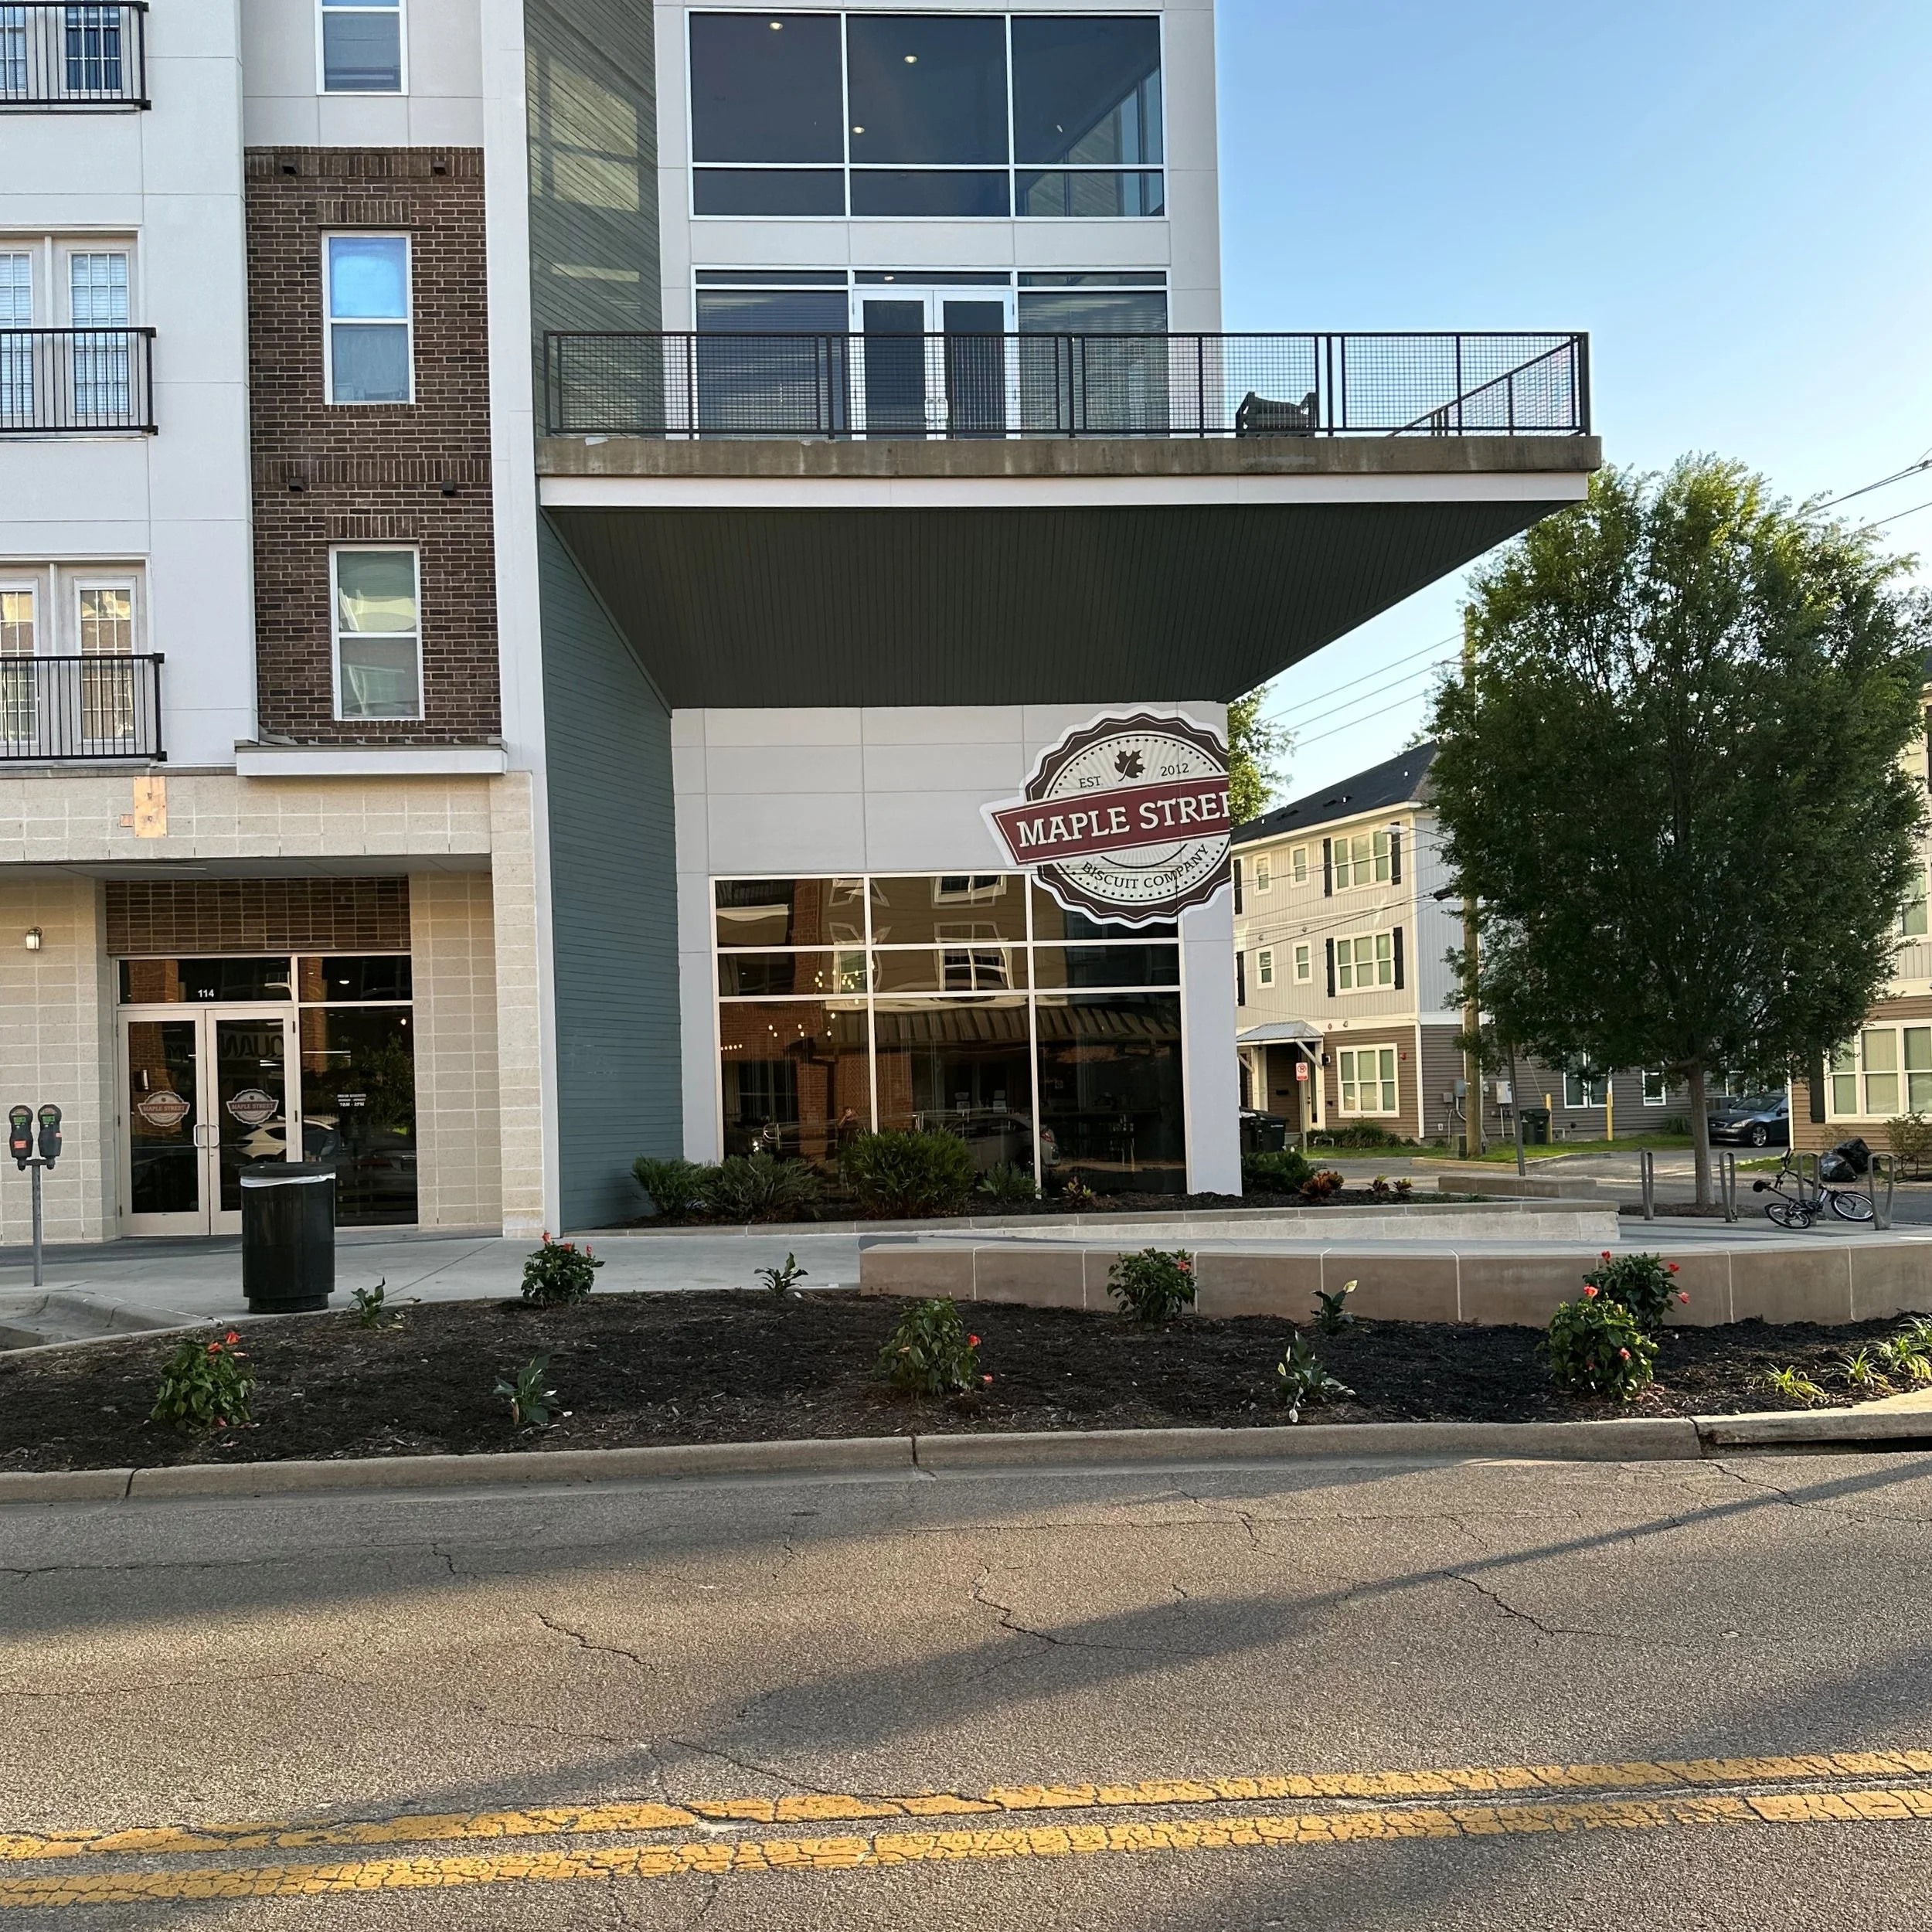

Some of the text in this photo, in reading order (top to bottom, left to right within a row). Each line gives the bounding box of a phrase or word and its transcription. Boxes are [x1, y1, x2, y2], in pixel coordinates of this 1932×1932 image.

[1161, 763, 1189, 776] 2012
[1016, 806, 1131, 848] MAPLE
[1082, 843, 1209, 889] BISCUIT COMPANY
[198, 989, 215, 998] 114
